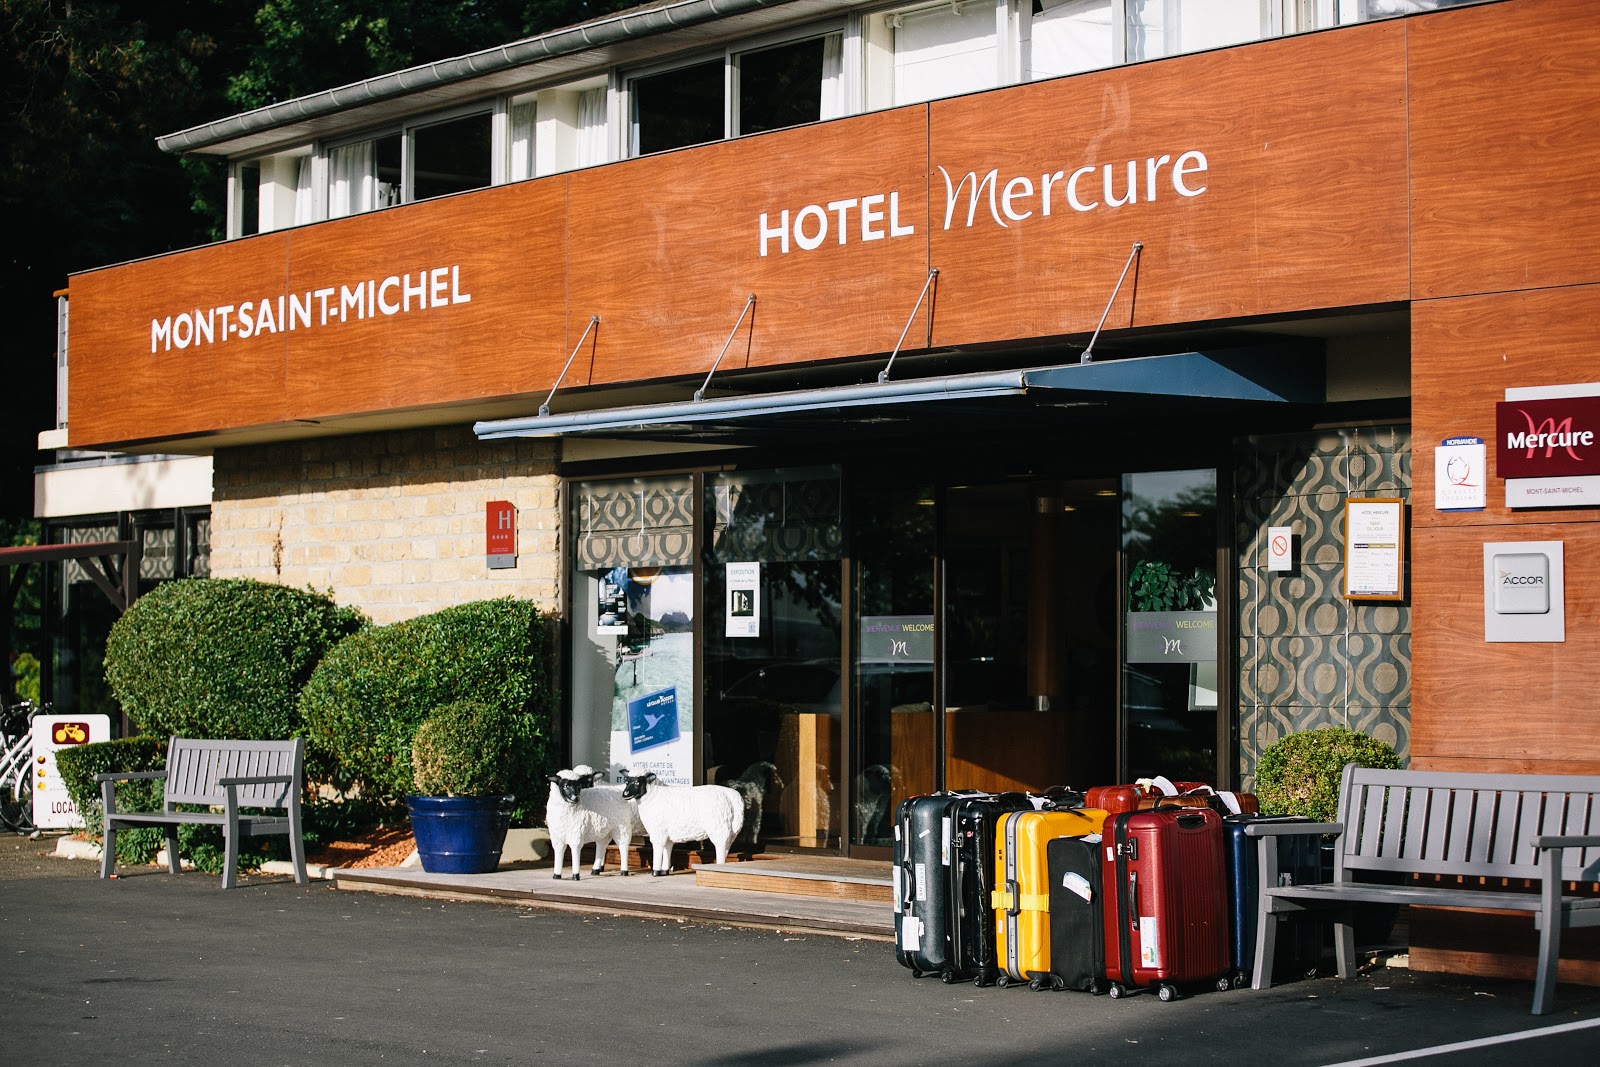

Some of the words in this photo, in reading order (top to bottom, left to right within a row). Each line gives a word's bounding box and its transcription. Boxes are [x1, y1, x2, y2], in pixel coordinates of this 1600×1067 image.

[758, 191, 915, 257] HOTEL
[936, 150, 1208, 231] Mercure
[151, 265, 472, 354] MONT-SAINT-MICHEL
[1446, 438, 1478, 446] NORMANDIE
[1507, 430, 1594, 449] Mercure
[1526, 487, 1584, 495] MONT-SAINT-MICHEL
[498, 510, 511, 530] H
[1503, 576, 1544, 585] ACCOR
[866, 624, 900, 633] BIENVENUE
[902, 623, 934, 632] WELCOME
[1175, 620, 1214, 629] WELCOME
